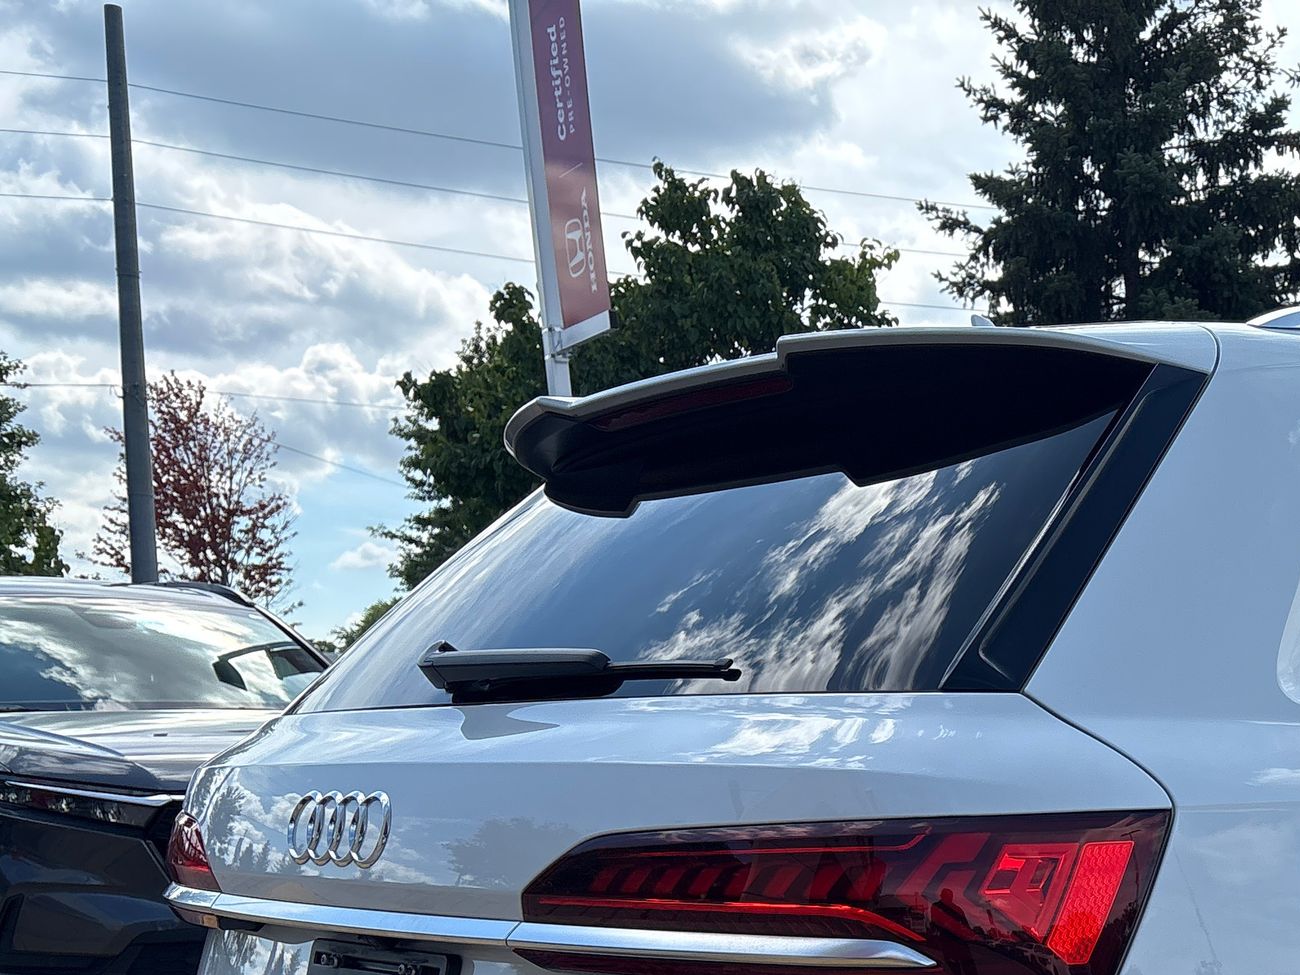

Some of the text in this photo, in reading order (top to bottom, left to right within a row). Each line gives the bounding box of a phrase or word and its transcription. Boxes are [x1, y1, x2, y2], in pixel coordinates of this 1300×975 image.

[547, 24, 567, 141] Certified
[559, 16, 575, 134] PRE-OWNED
[581, 186, 597, 294] HONDA
